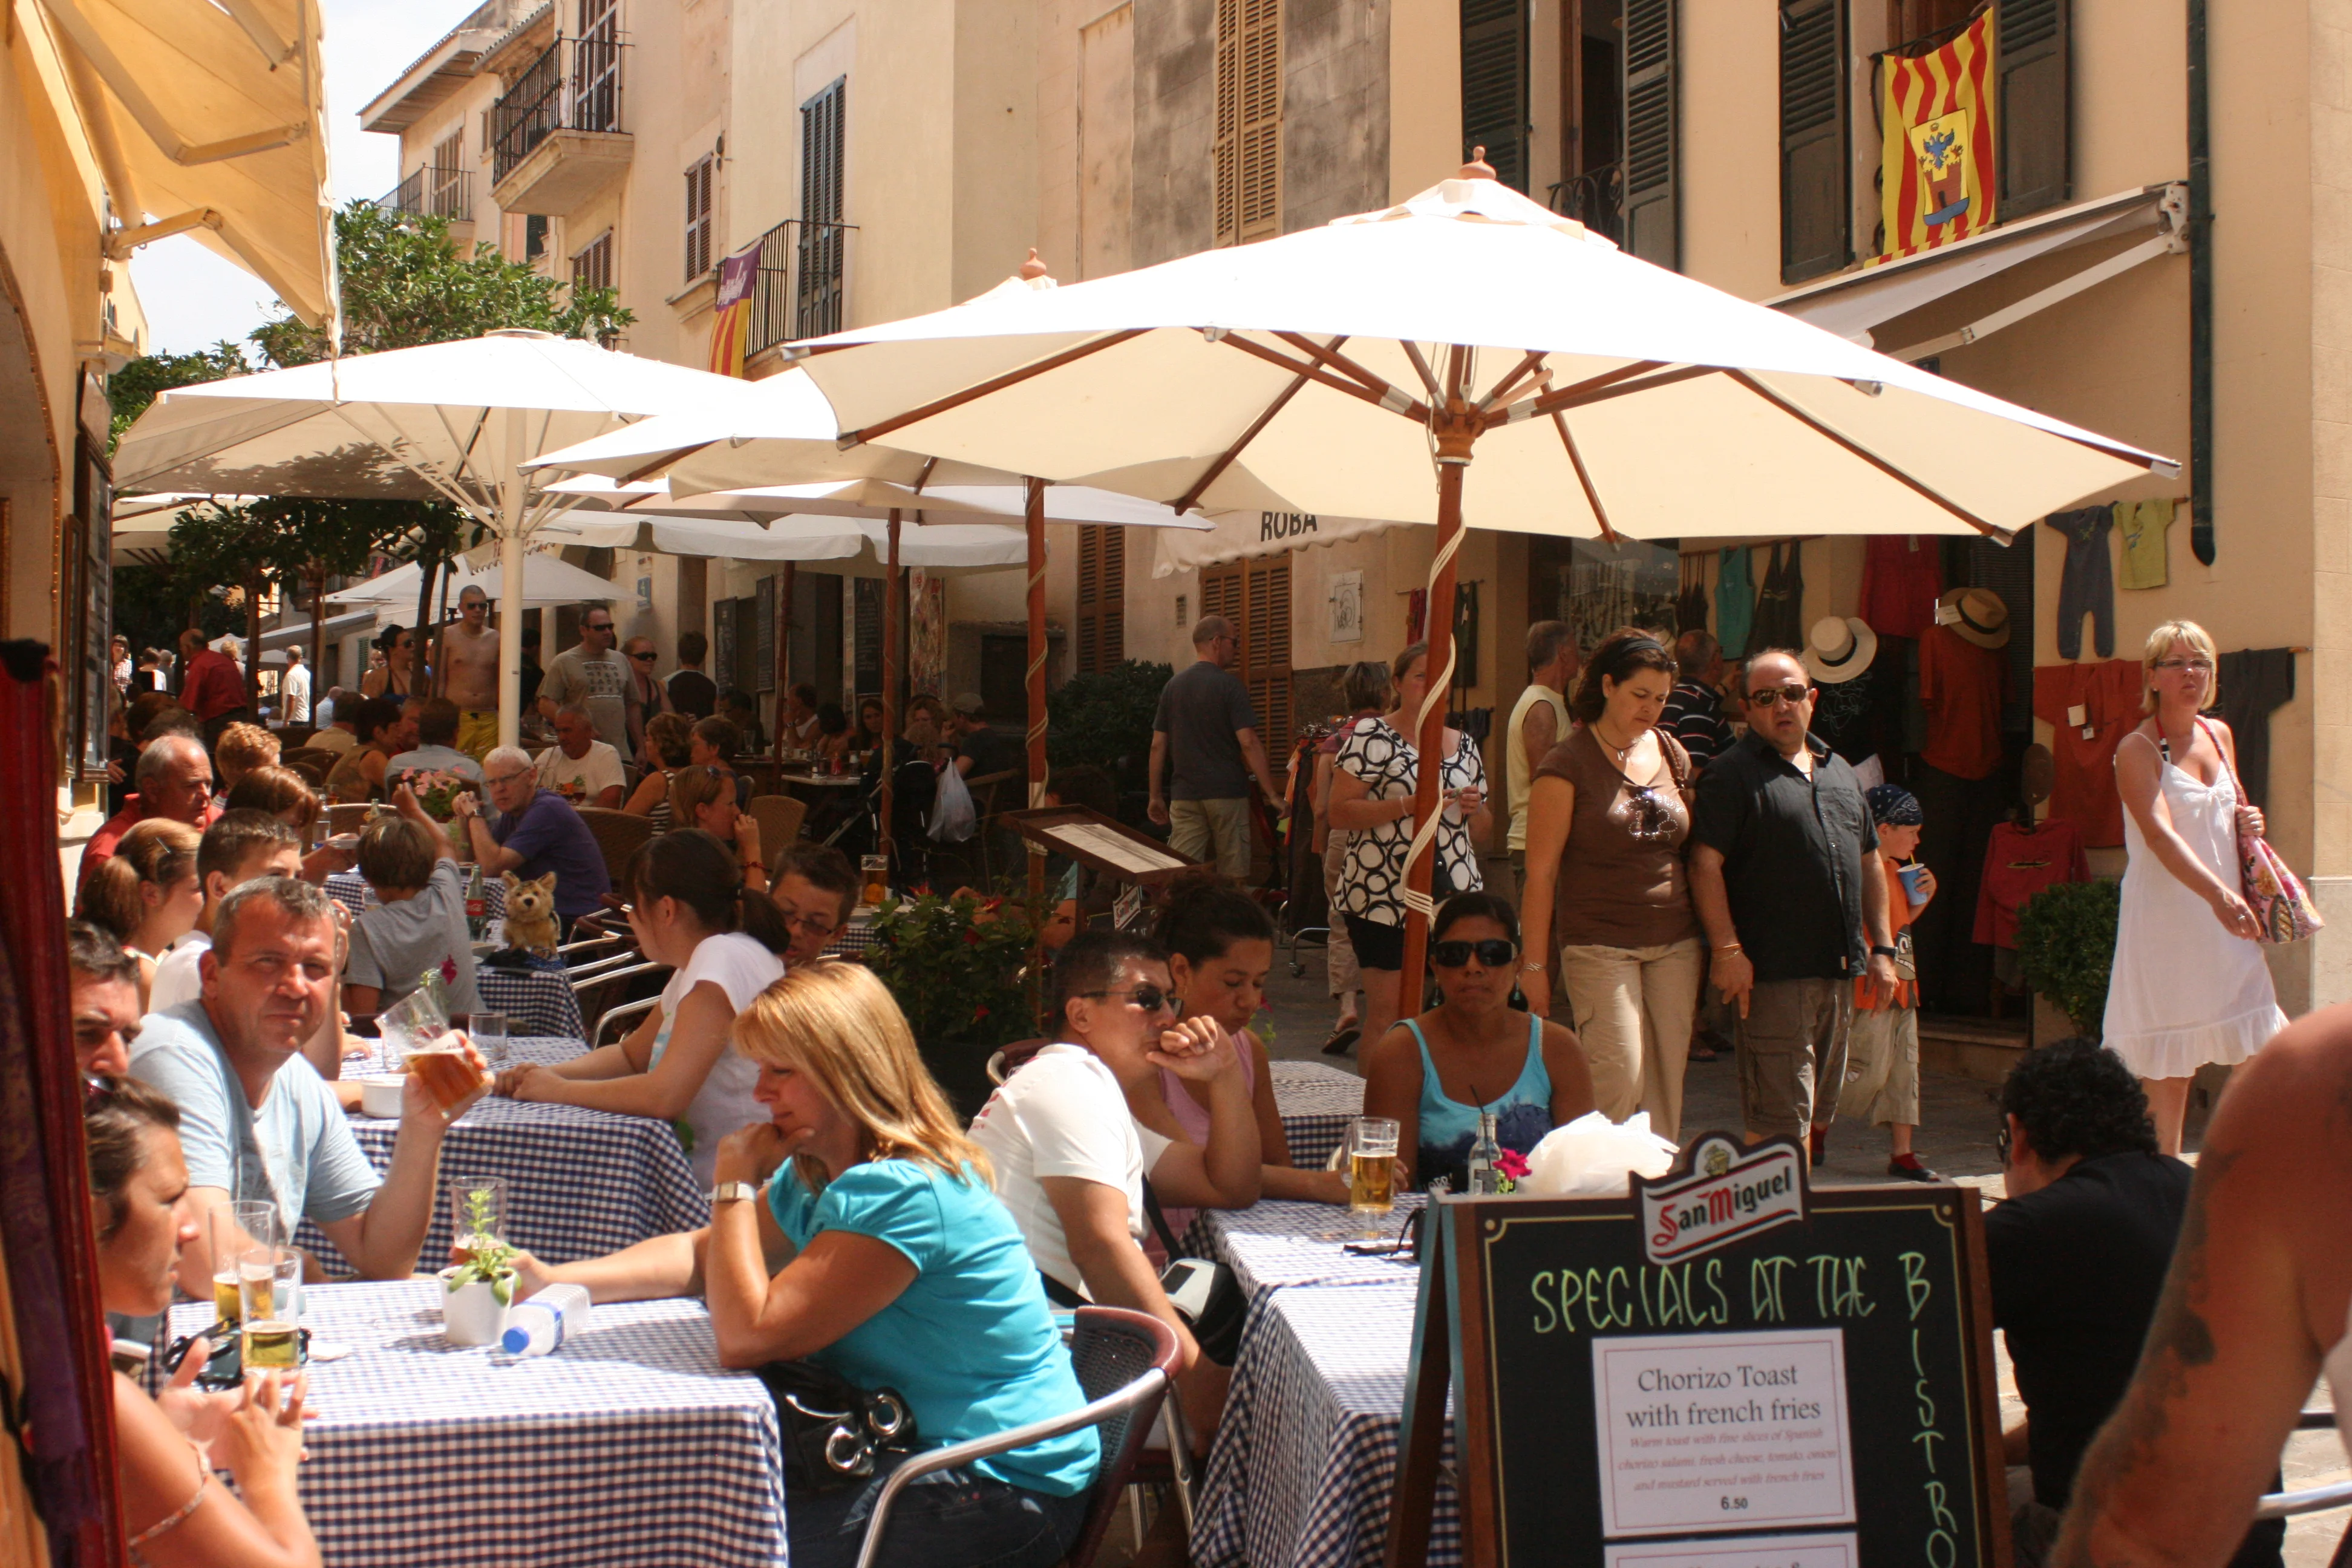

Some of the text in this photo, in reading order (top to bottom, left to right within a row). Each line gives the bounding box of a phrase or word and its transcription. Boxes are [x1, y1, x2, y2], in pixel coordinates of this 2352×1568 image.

[1261, 512, 1318, 542] ROBA
[1531, 1258, 1728, 1333] SPECIALS
[1751, 1255, 1797, 1322] AT
[1806, 1255, 1876, 1319] THE
[1638, 1364, 1798, 1392] Chorizo Toast
[1626, 1397, 1821, 1428] with french fries
[1694, 1434, 1716, 1445] with
[1720, 1495, 1748, 1510] 6.50
